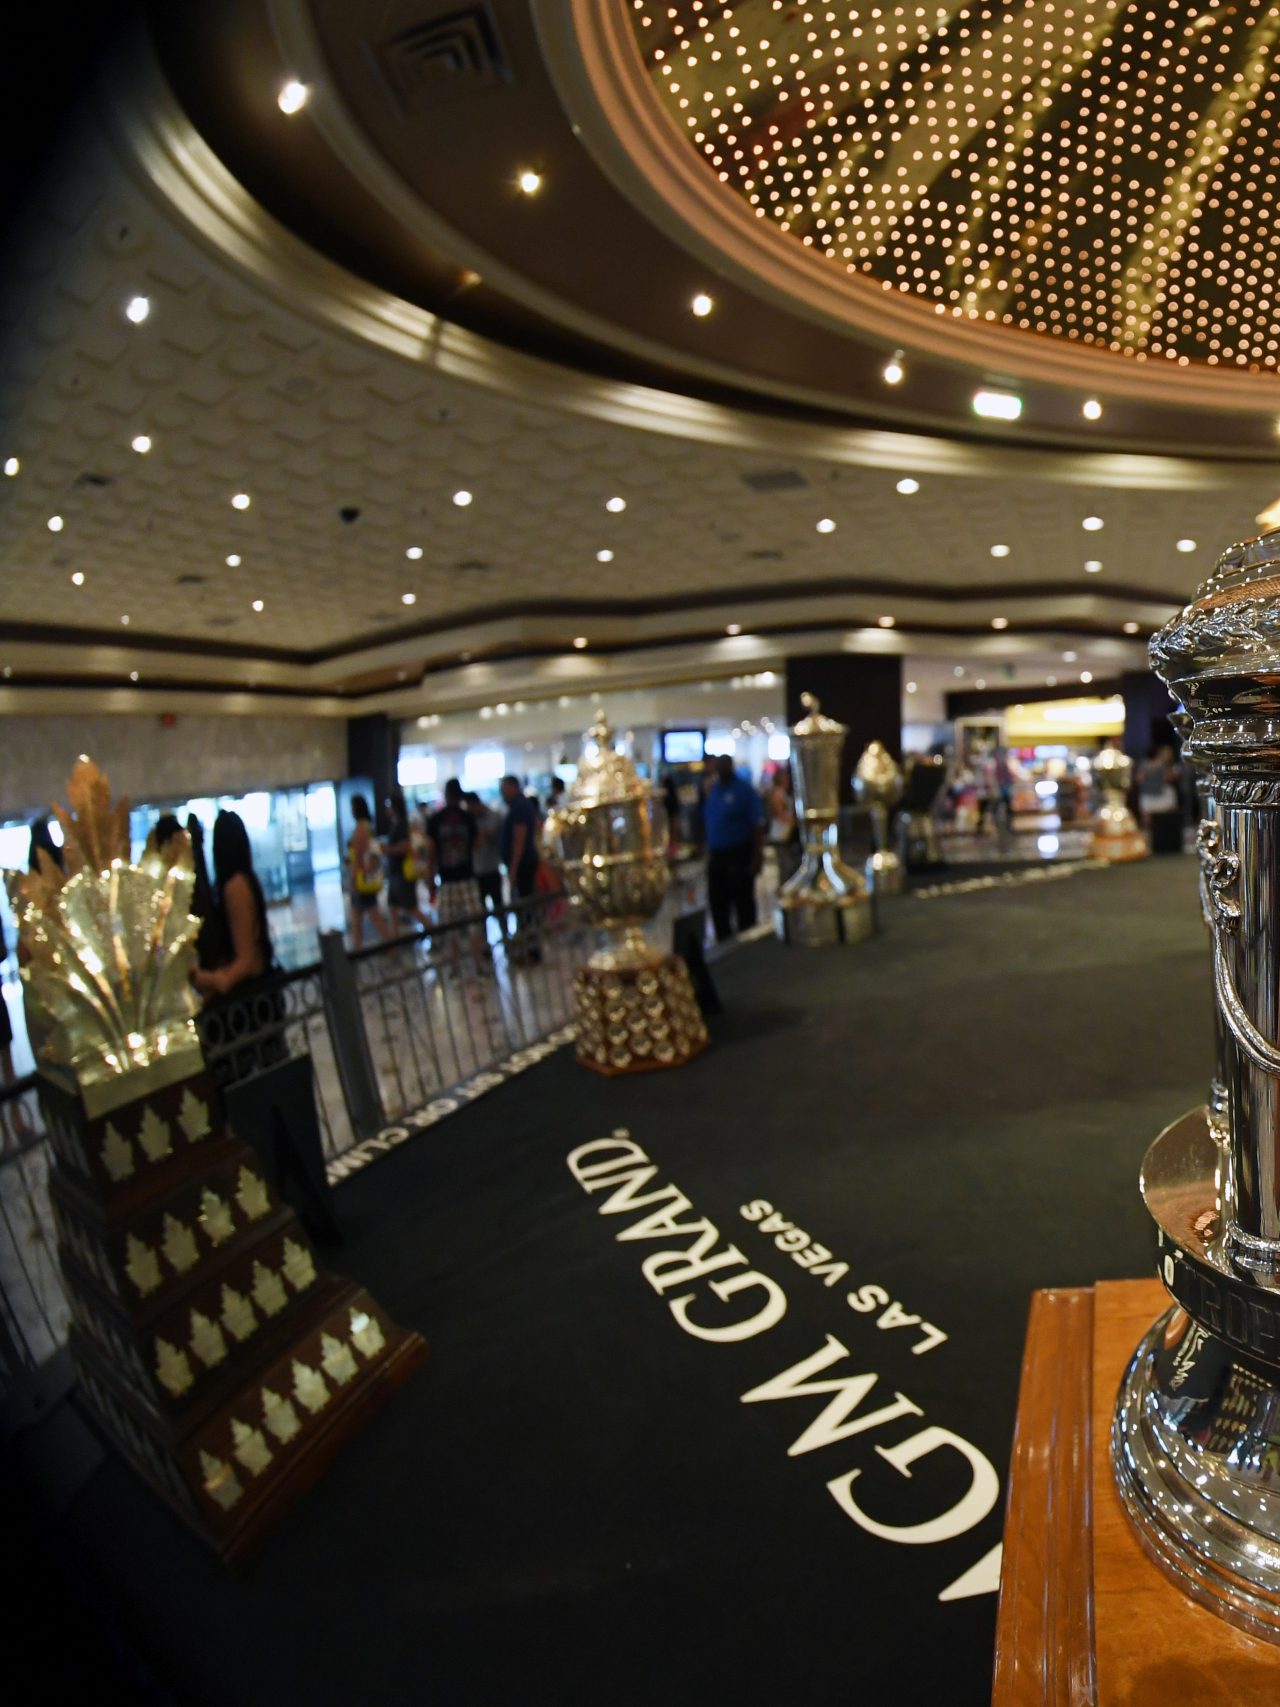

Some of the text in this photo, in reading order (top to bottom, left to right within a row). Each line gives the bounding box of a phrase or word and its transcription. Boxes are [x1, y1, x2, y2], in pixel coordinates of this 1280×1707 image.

[566, 1137, 788, 1343] GRAND
[740, 1199, 948, 1355] LAS VEGAS
